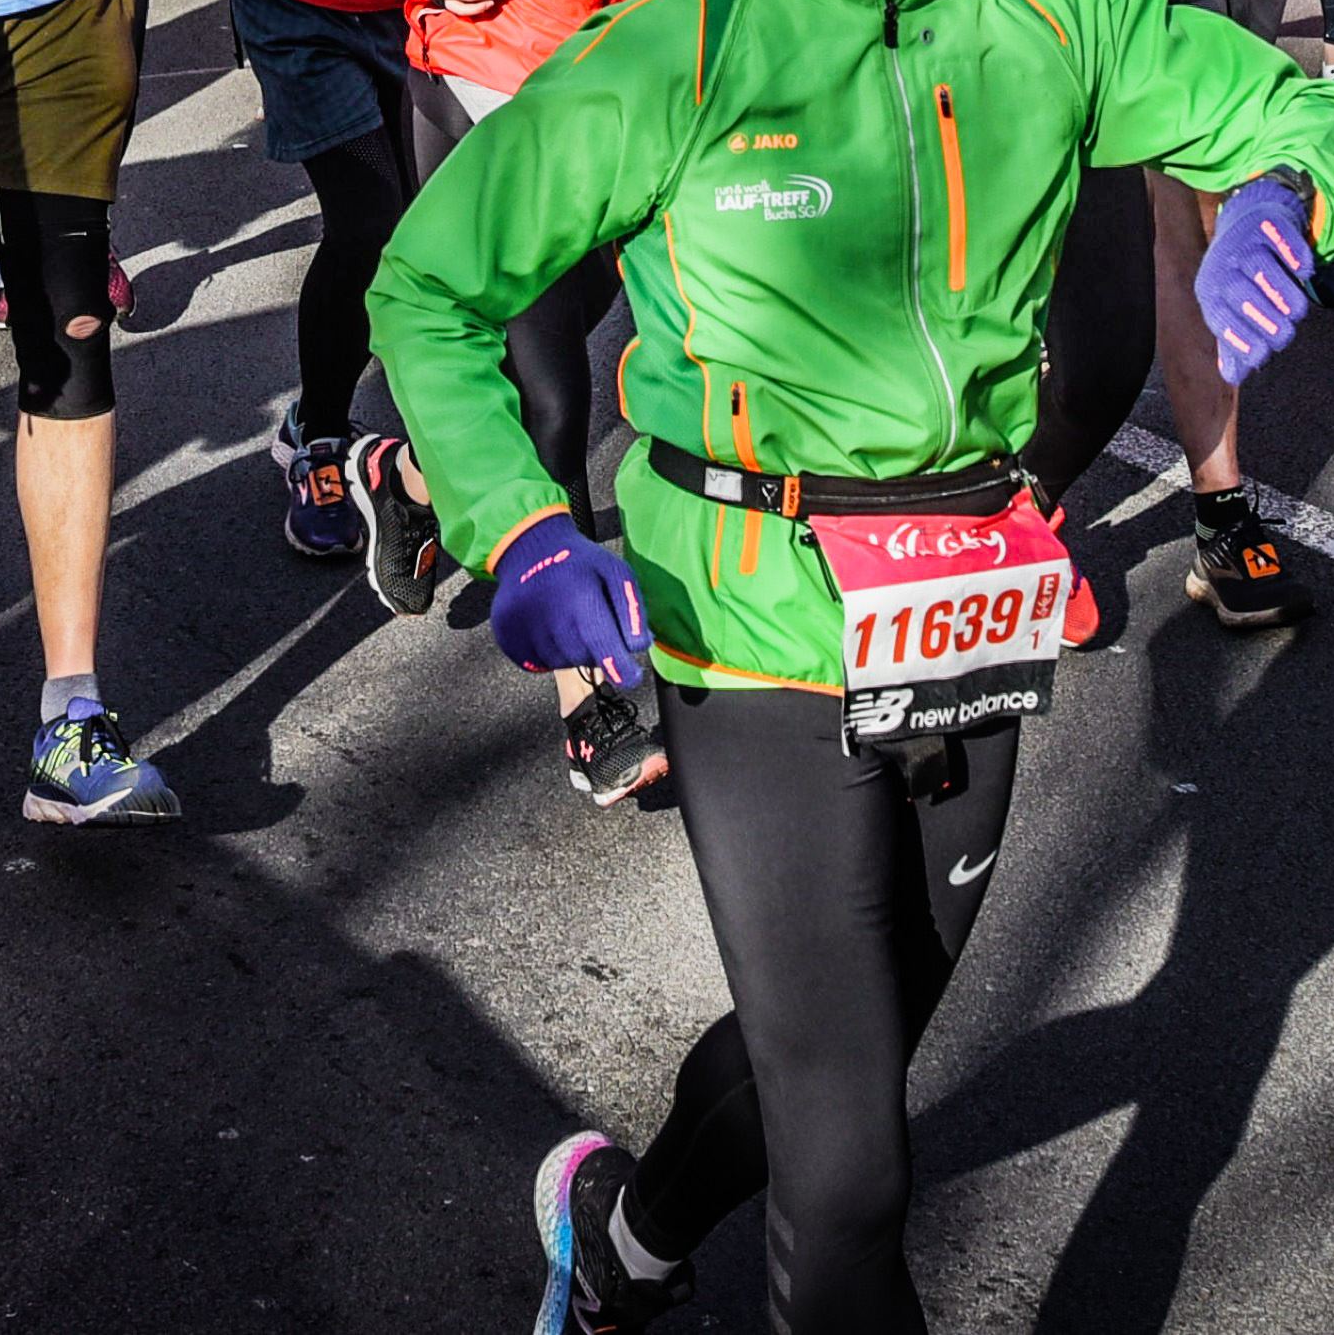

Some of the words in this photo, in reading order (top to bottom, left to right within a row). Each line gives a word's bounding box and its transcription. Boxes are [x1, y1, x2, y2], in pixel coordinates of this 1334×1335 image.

[753, 134, 798, 150] JAKO
[715, 190, 811, 211] LAUF-TREFF
[764, 206, 797, 221] Buchs
[798, 205, 817, 219] SG
[854, 588, 1025, 669] 11639
[909, 707, 955, 730] new
[959, 689, 1039, 724] balance
